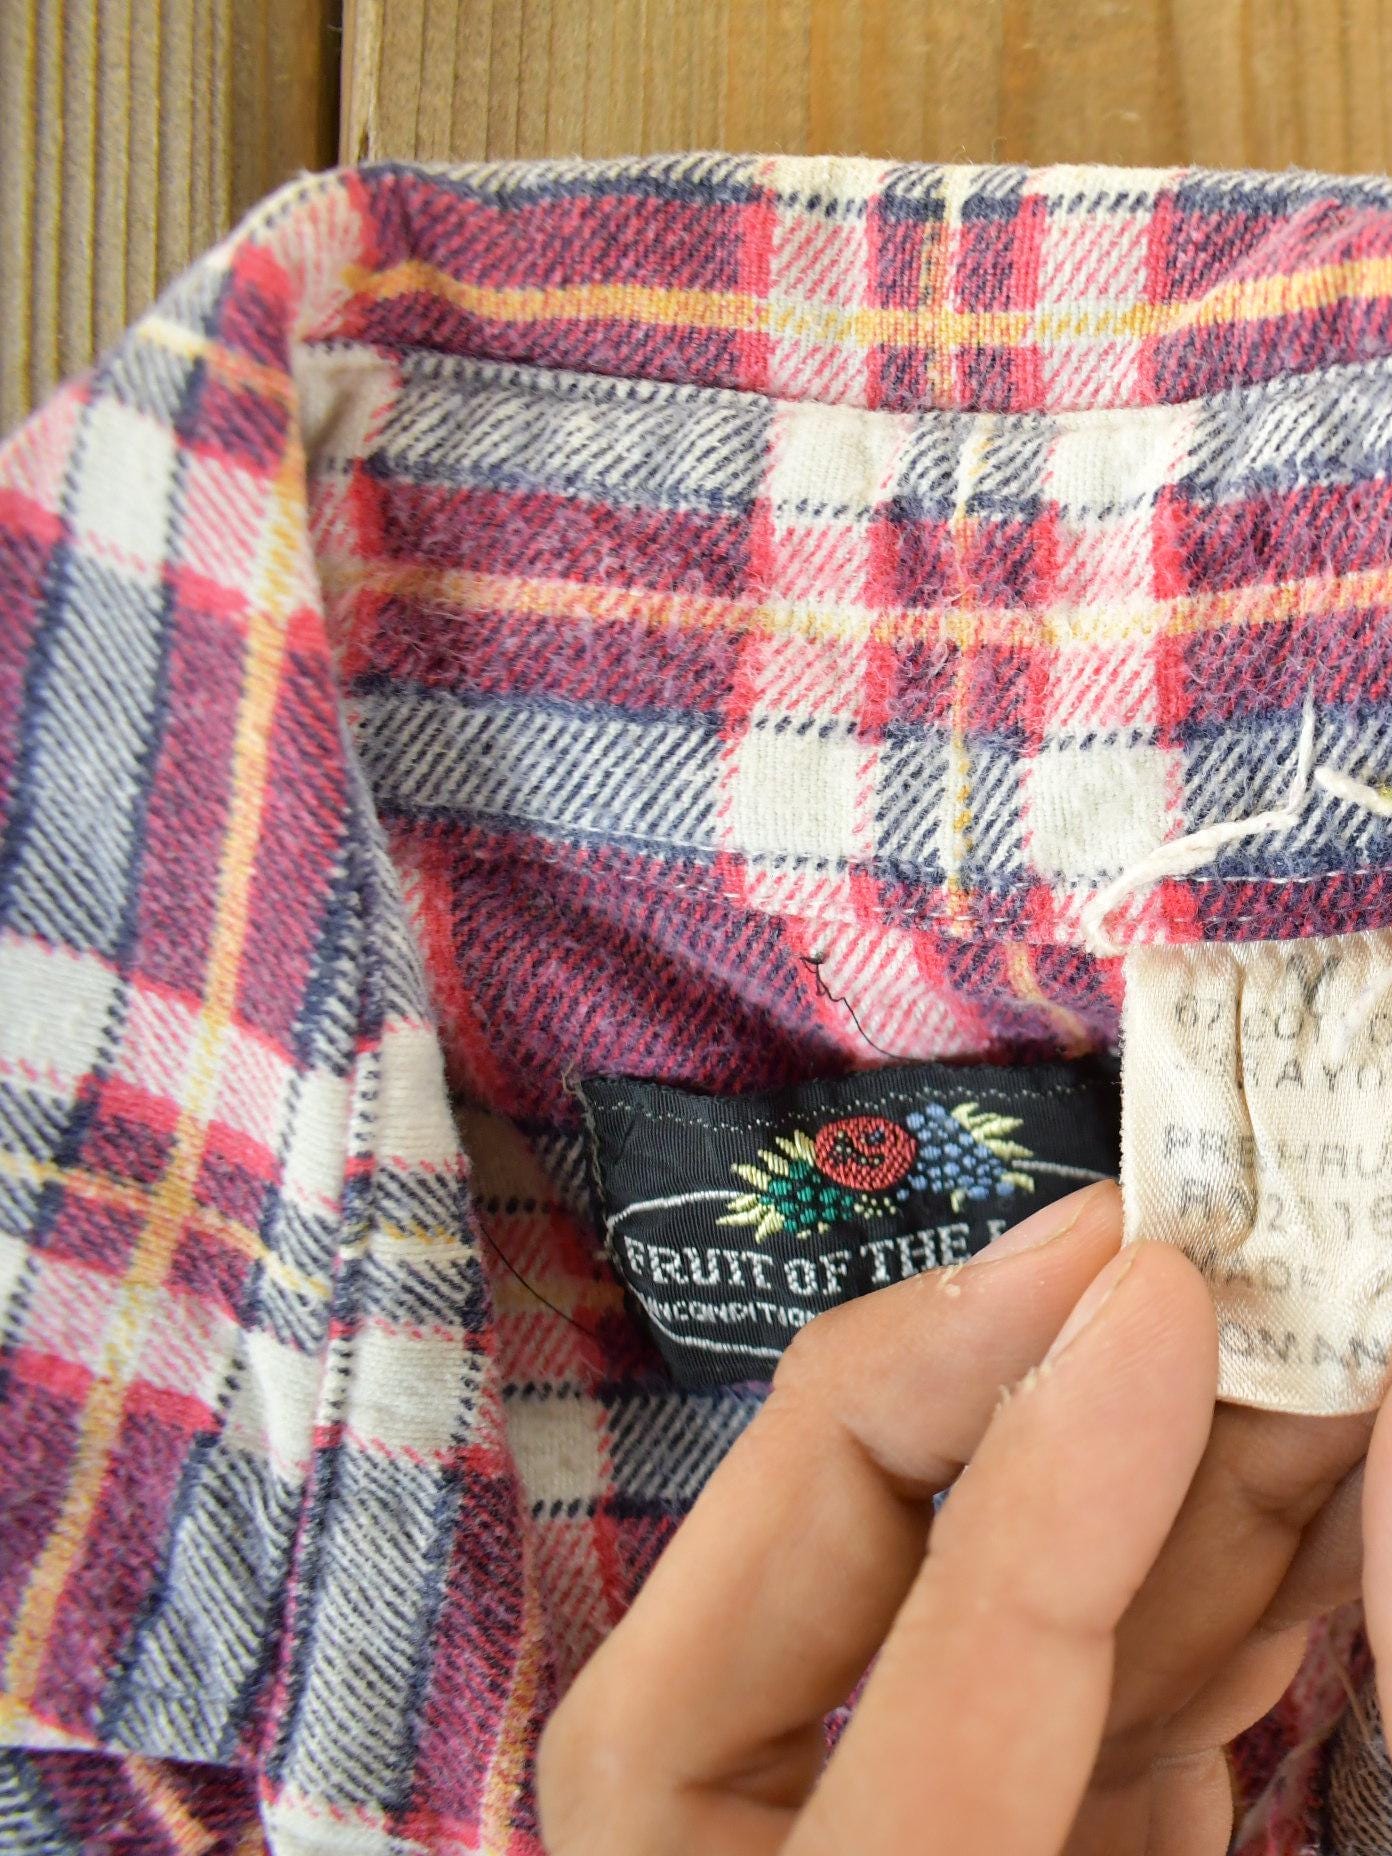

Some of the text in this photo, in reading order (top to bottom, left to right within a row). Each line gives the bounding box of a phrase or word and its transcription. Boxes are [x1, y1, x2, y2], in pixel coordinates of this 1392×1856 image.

[623, 1234, 774, 1289] FRUIT
[784, 1249, 850, 1296] OF
[859, 1222, 973, 1284] THE
